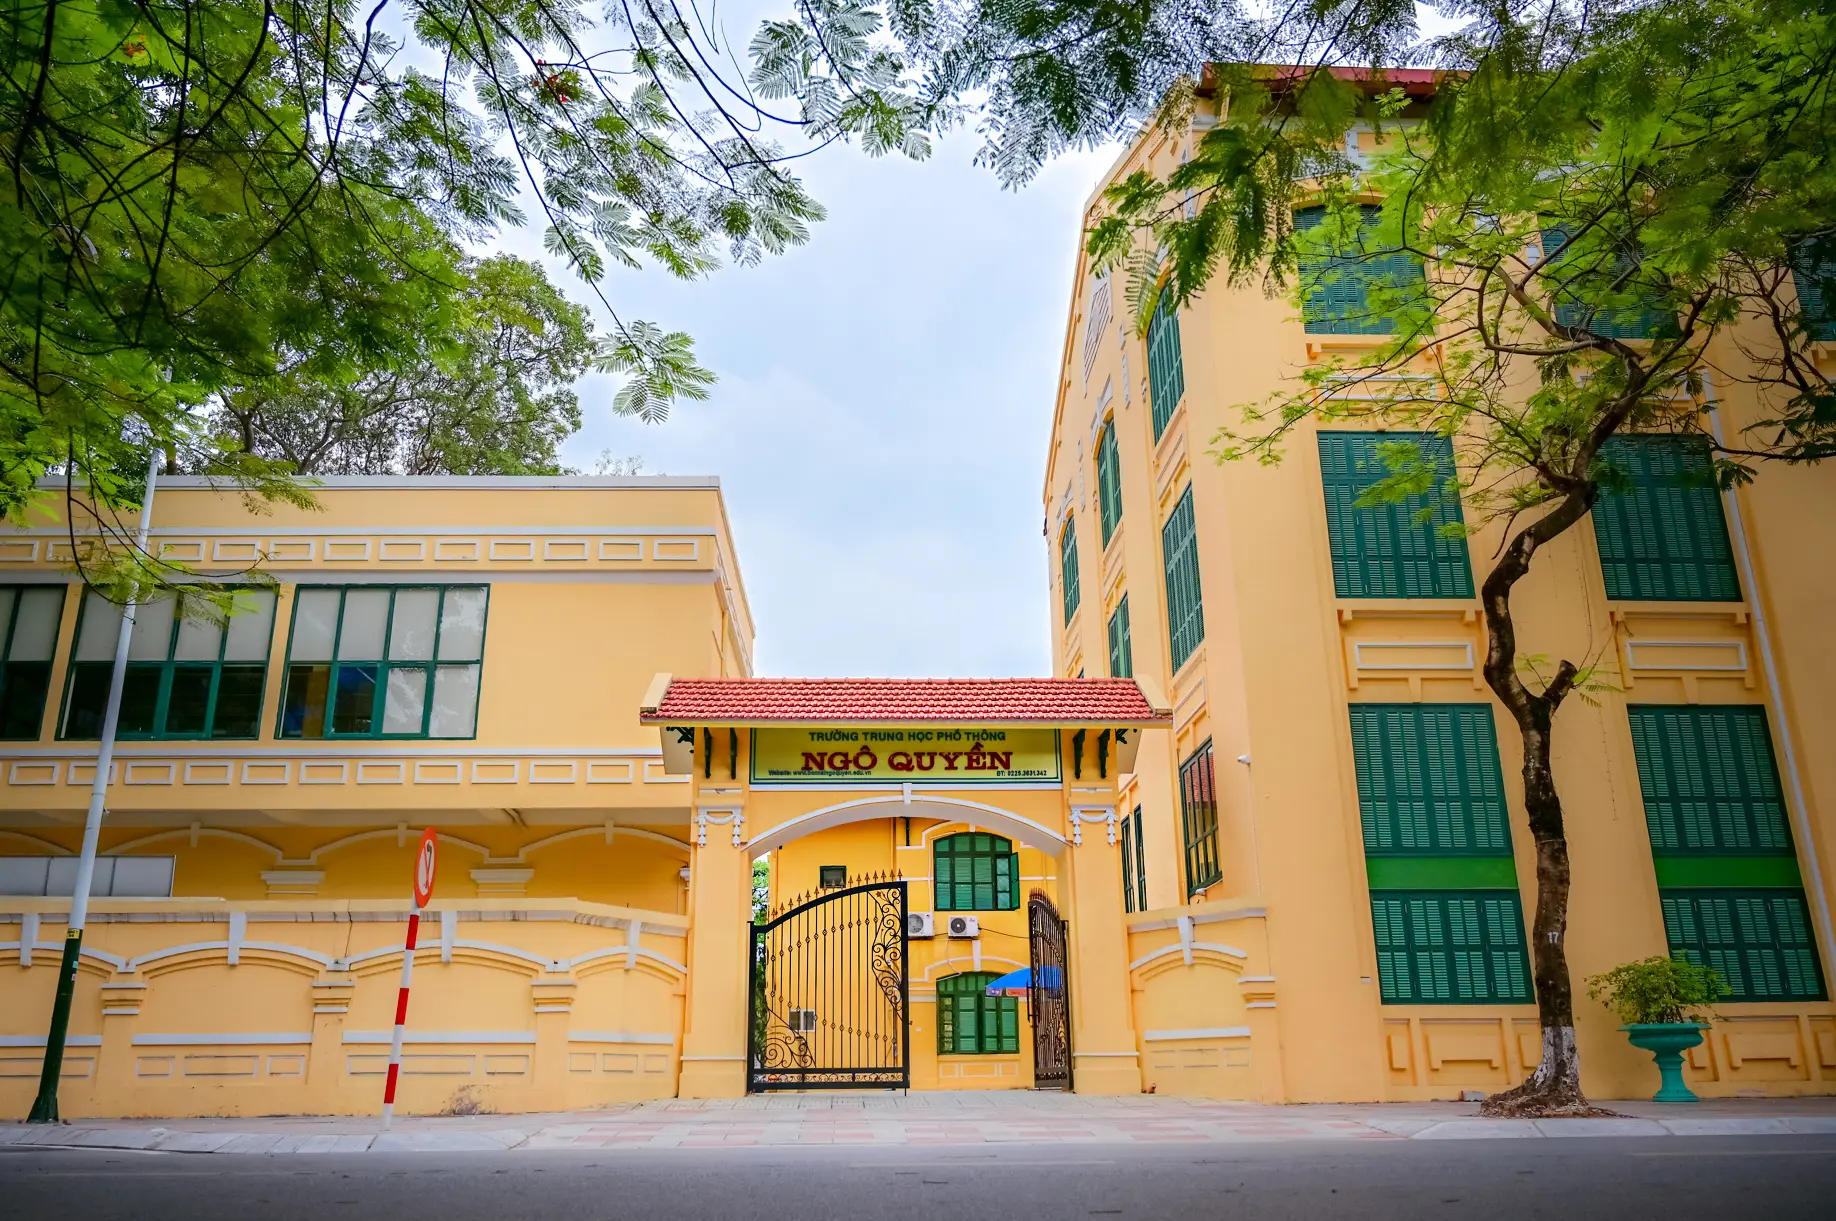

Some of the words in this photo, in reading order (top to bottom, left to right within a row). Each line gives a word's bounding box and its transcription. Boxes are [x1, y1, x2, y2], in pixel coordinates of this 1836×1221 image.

[809, 729, 858, 742] TRƯỜNG
[862, 732, 904, 742] TRUNG
[908, 732, 933, 743] HỌC
[937, 729, 962, 742] PHỔ
[965, 729, 1006, 741] THÔNG
[802, 745, 877, 770] NGÔ
[887, 742, 1012, 771] QUYỀN
[1547, 931, 1559, 944] 17
